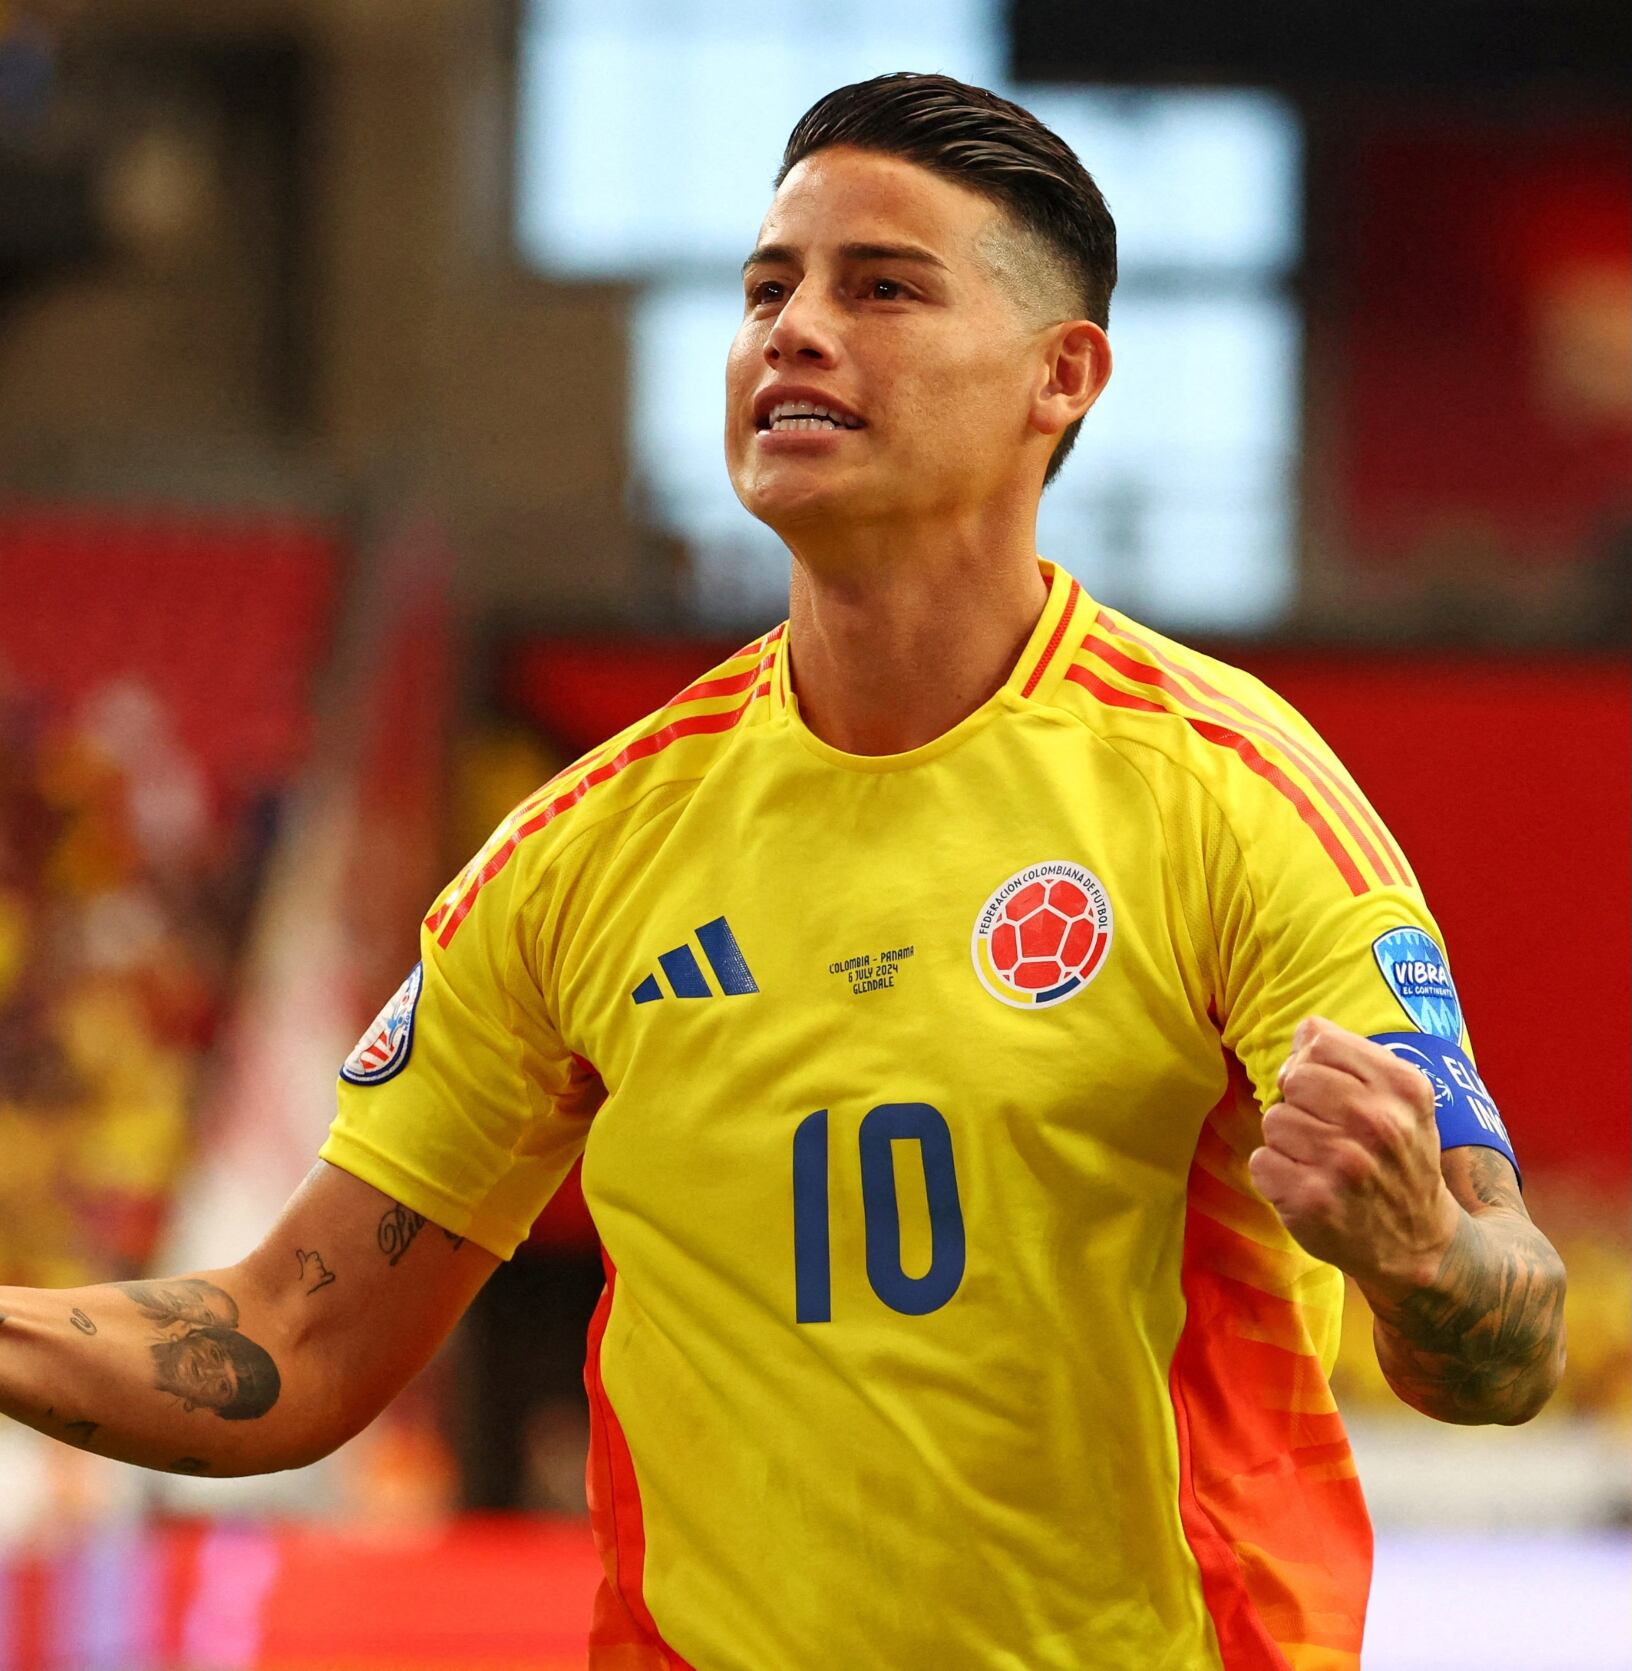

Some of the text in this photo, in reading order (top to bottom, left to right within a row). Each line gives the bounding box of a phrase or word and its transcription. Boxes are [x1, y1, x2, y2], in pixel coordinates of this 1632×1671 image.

[1022, 865, 1084, 883] COLOMBIANA
[1082, 876, 1096, 892] DE
[829, 955, 870, 974] COLOMBIA
[855, 967, 873, 981] JULY
[876, 964, 898, 976] 2024
[1394, 961, 1449, 987] VIBRA
[853, 976, 894, 994] GLENDALE
[1402, 986, 1414, 996] EL
[792, 1102, 966, 1324] 10
